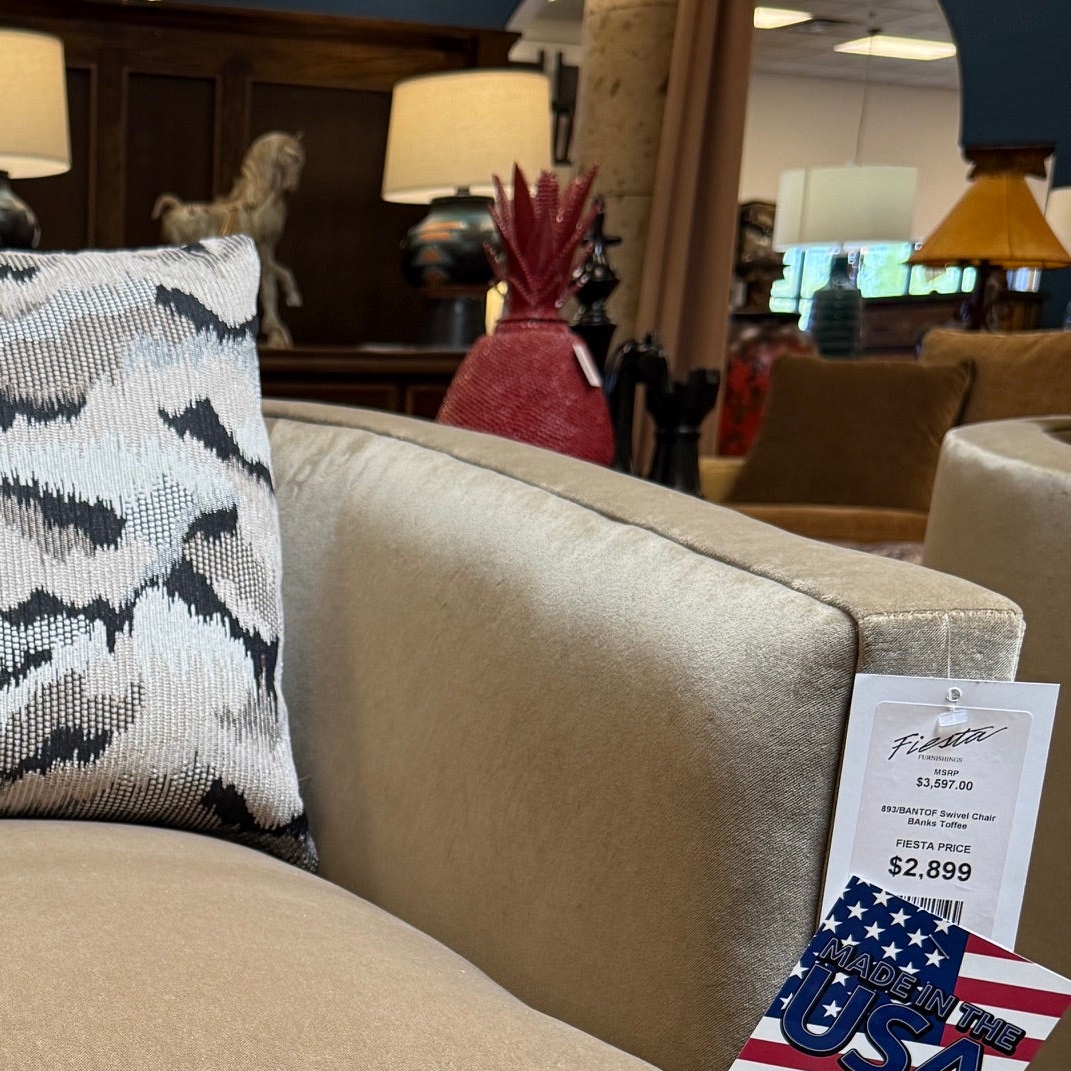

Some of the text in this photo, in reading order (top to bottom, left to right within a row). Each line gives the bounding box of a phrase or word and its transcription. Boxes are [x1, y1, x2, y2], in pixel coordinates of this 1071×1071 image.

[888, 725, 1008, 760] Fiesta
[918, 754, 963, 763] FURNISHINGS
[934, 768, 960, 777] MSRP
[916, 776, 974, 791] $3,597.00
[881, 805, 997, 822] 893/BANTOF Swivel Chair
[907, 817, 968, 830] BAnks Toffee
[895, 839, 972, 854] FIESTA PRICE
[888, 855, 972, 882] $2,899
[819, 937, 1024, 1053] MADE IN THE
